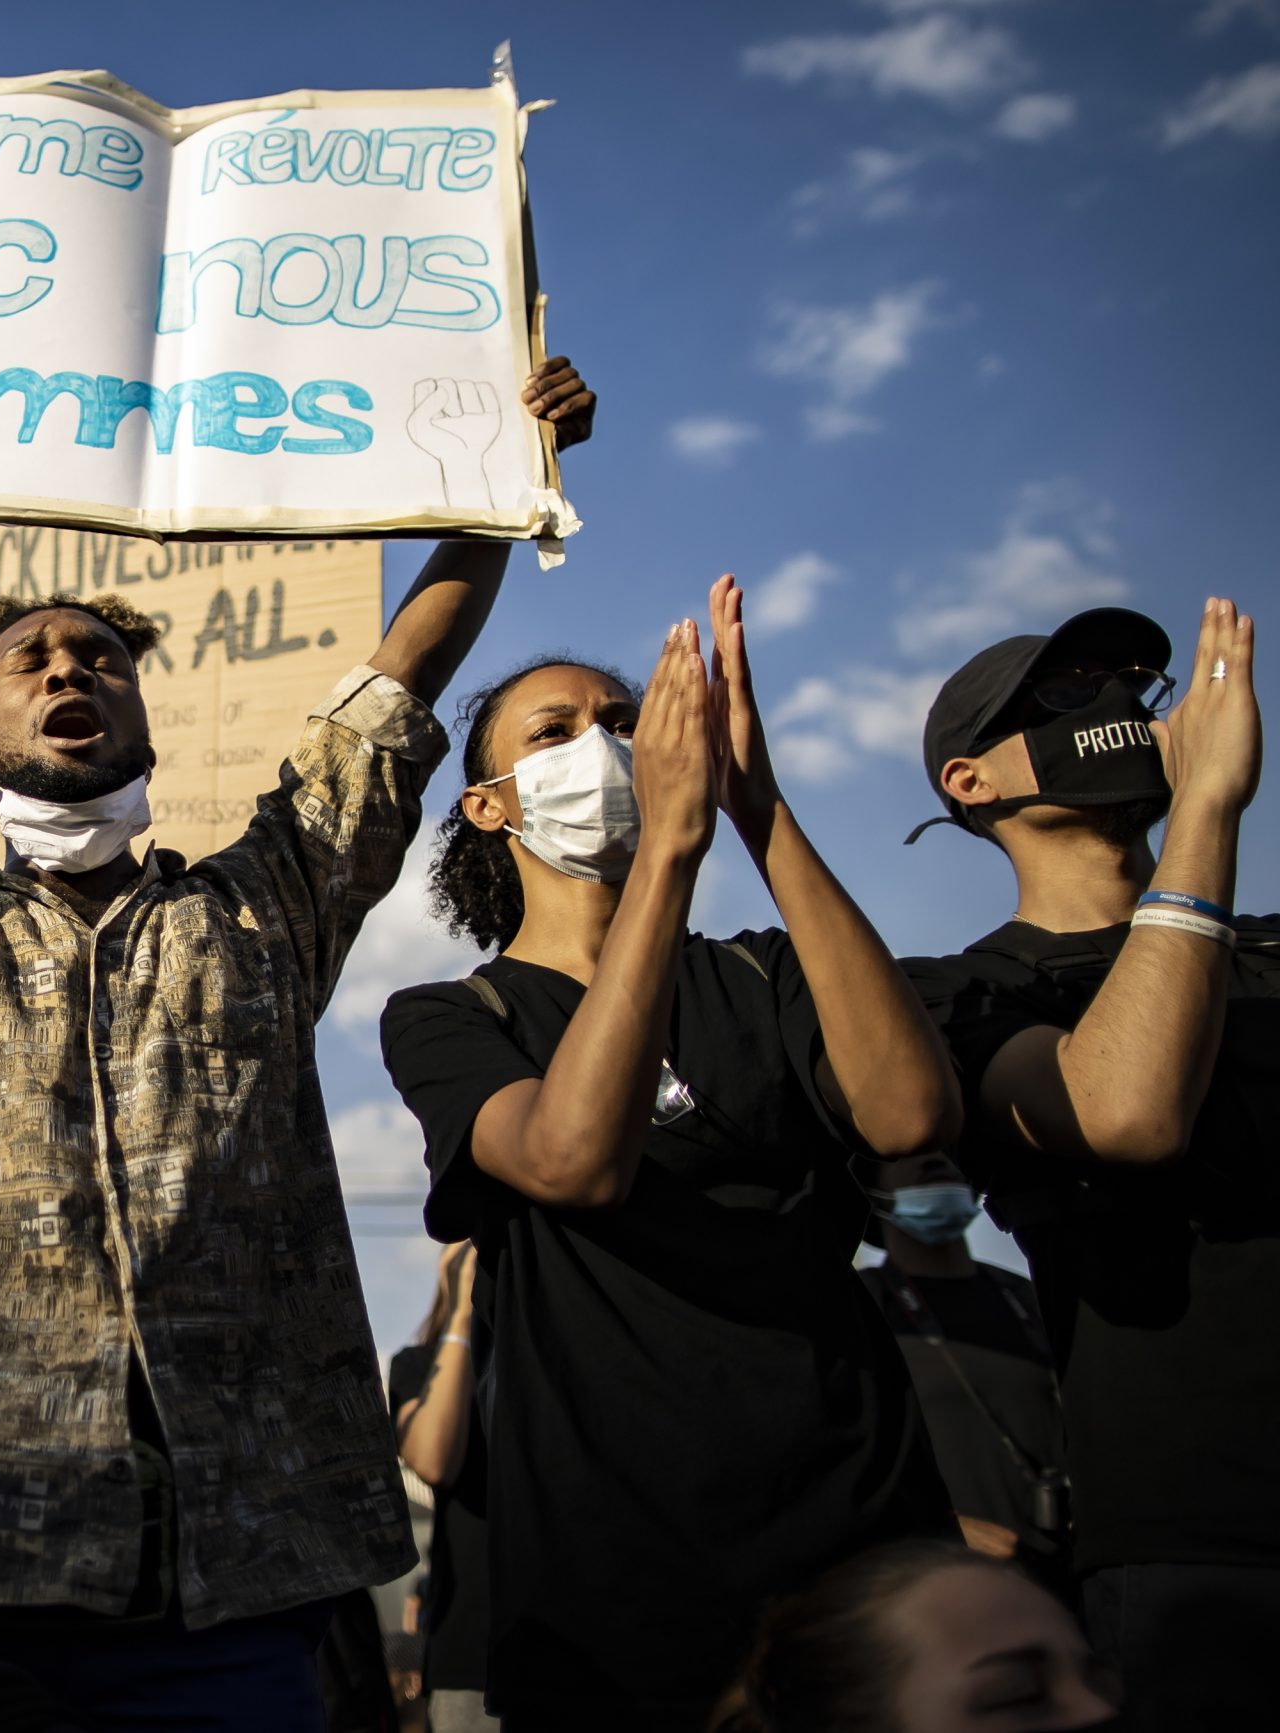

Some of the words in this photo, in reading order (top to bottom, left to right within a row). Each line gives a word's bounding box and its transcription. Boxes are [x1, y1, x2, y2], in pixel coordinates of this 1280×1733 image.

[191, 577, 338, 670] ALL.
[1073, 721, 1152, 758] PROTO
[1159, 893, 1196, 907] Supreme
